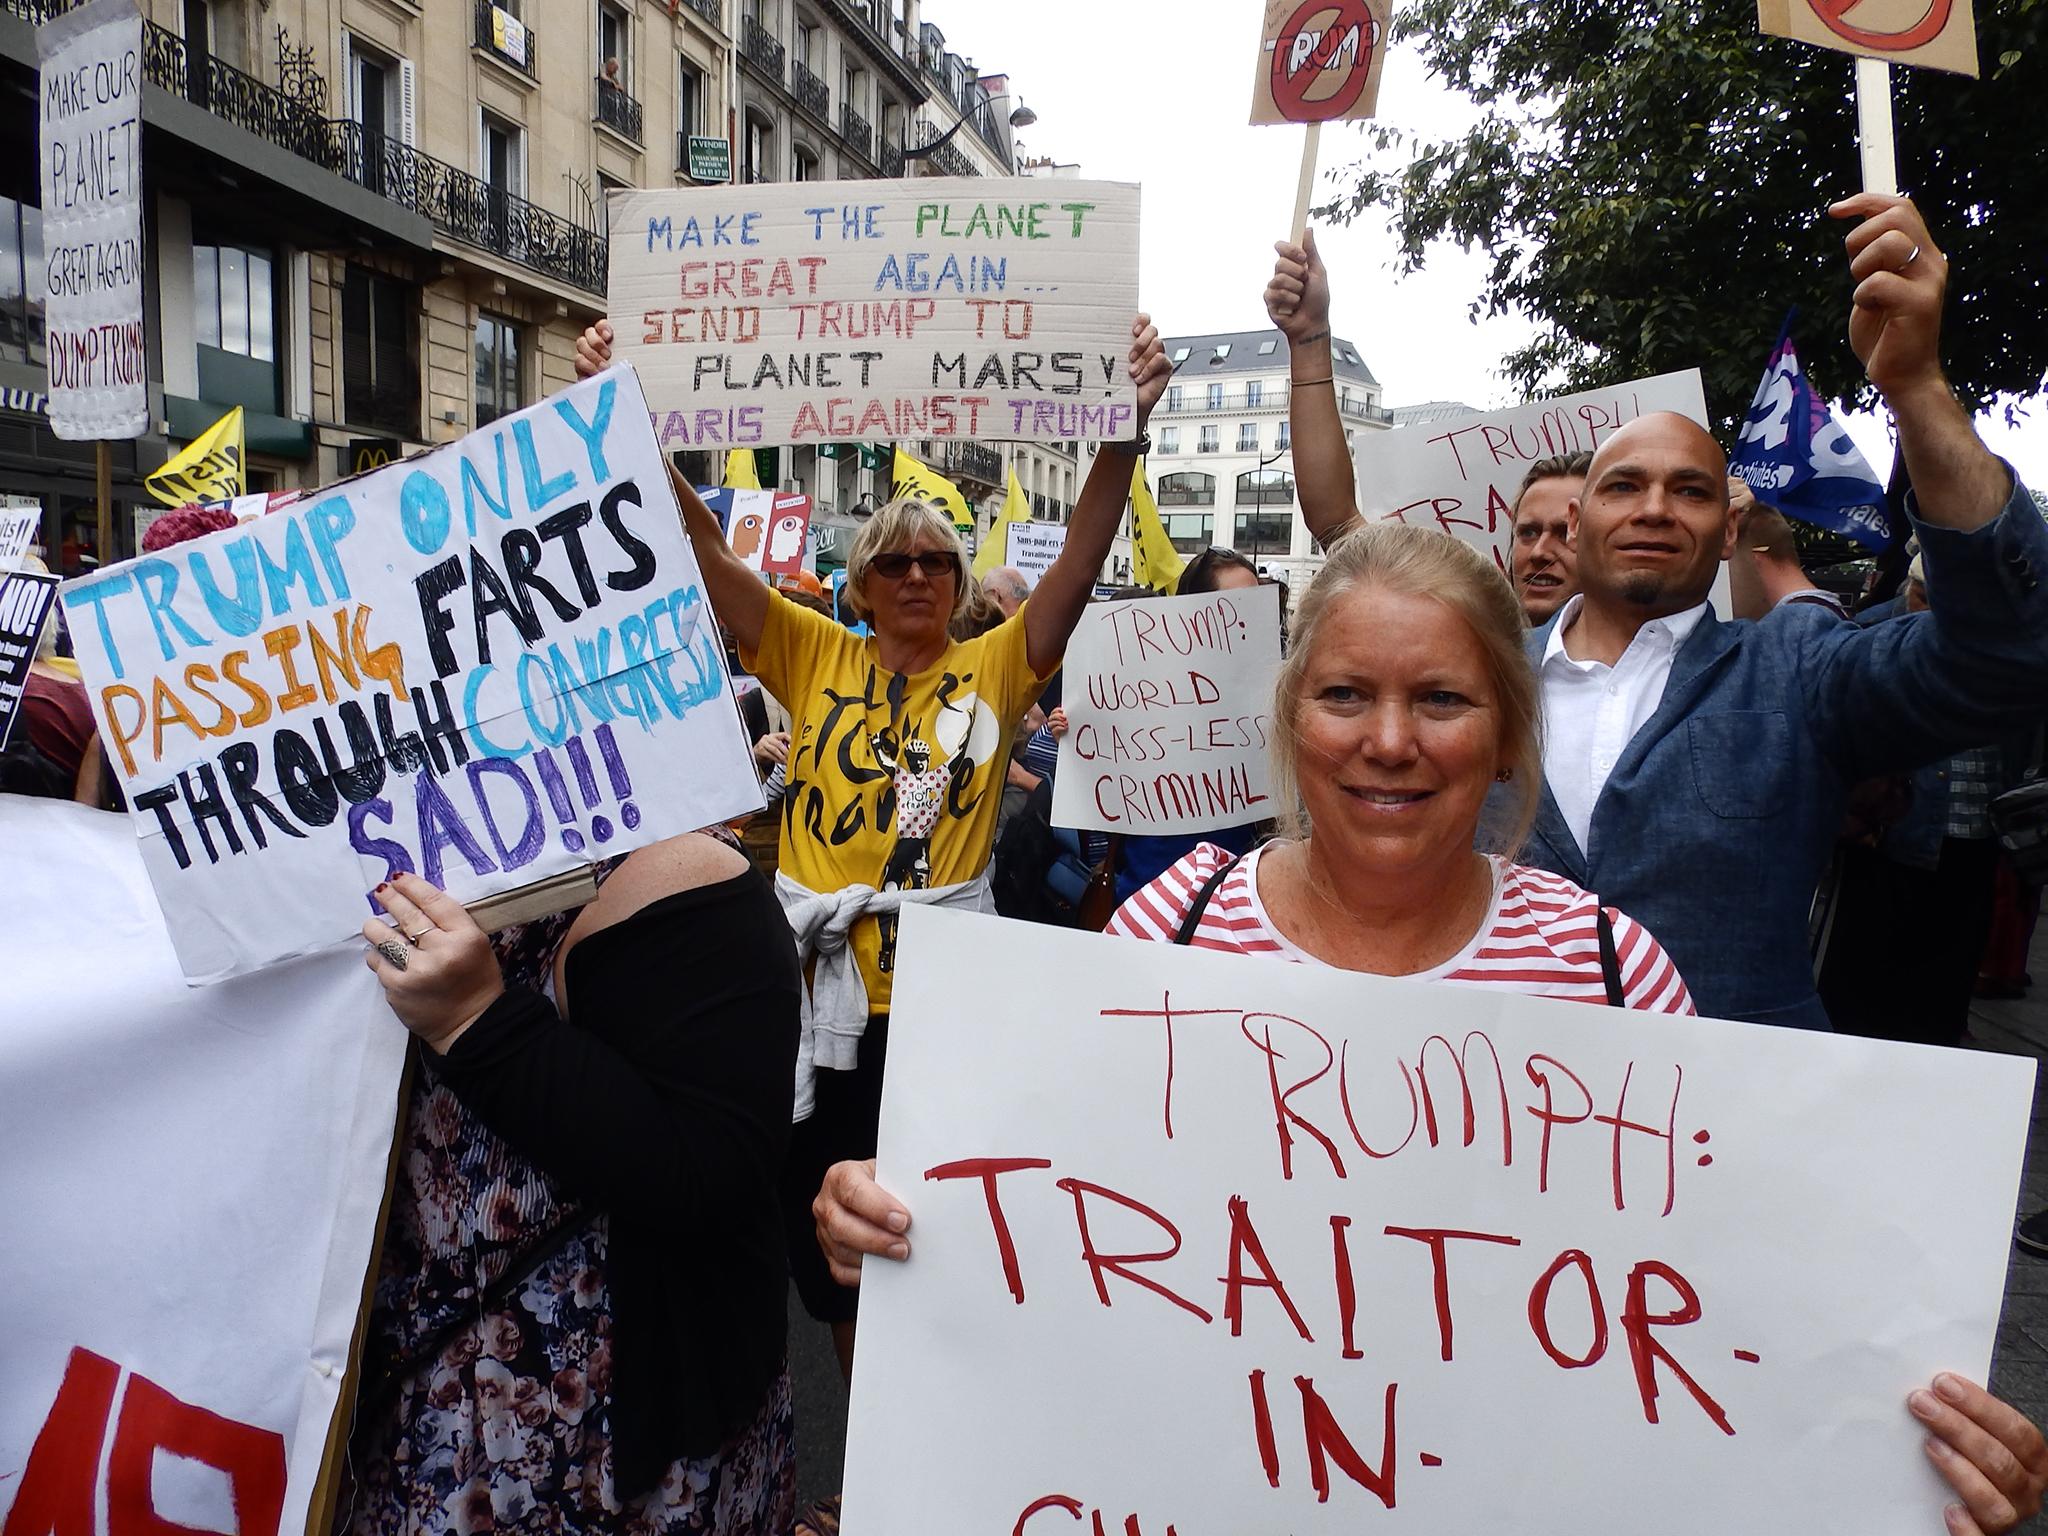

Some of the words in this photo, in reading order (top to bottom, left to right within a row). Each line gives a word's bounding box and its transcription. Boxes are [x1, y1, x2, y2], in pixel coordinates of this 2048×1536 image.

[47, 66, 90, 123] MAKE
[95, 50, 137, 104] OUR
[53, 118, 136, 208] PLANET
[699, 140, 727, 150] VENDRE
[648, 211, 763, 253] MAKE
[804, 205, 886, 242] THE
[915, 203, 1097, 240] PLANET
[48, 243, 94, 296] GREAT
[97, 239, 140, 291] AGAIN
[680, 256, 828, 300] GREAT
[50, 327, 99, 390] DUMP
[99, 321, 143, 386] TRUMP
[642, 305, 761, 345] SEND
[788, 298, 936, 342] TRUMP
[965, 299, 1034, 341] TO
[693, 351, 883, 393] PLANET
[931, 351, 1117, 398] MARS!
[790, 396, 990, 440] AGAINST
[1007, 399, 1132, 437] TRUMP
[64, 493, 357, 680] TRUMP
[399, 379, 619, 556] ONLY
[102, 602, 412, 778] PASSING
[412, 481, 657, 680] FARTS
[1100, 597, 1247, 666] TRUMP:
[1088, 670, 1221, 711] WORLD
[1075, 715, 1269, 764] CLASS-LESS
[132, 680, 470, 871] THROUGH
[1094, 762, 1269, 825] CRIMINAL
[346, 722, 643, 916] SAD!!!
[1100, 990, 1713, 1217] TRUMPH:
[924, 1157, 1761, 1436] TRAITOR-
[1248, 1368, 1443, 1509] IN-
